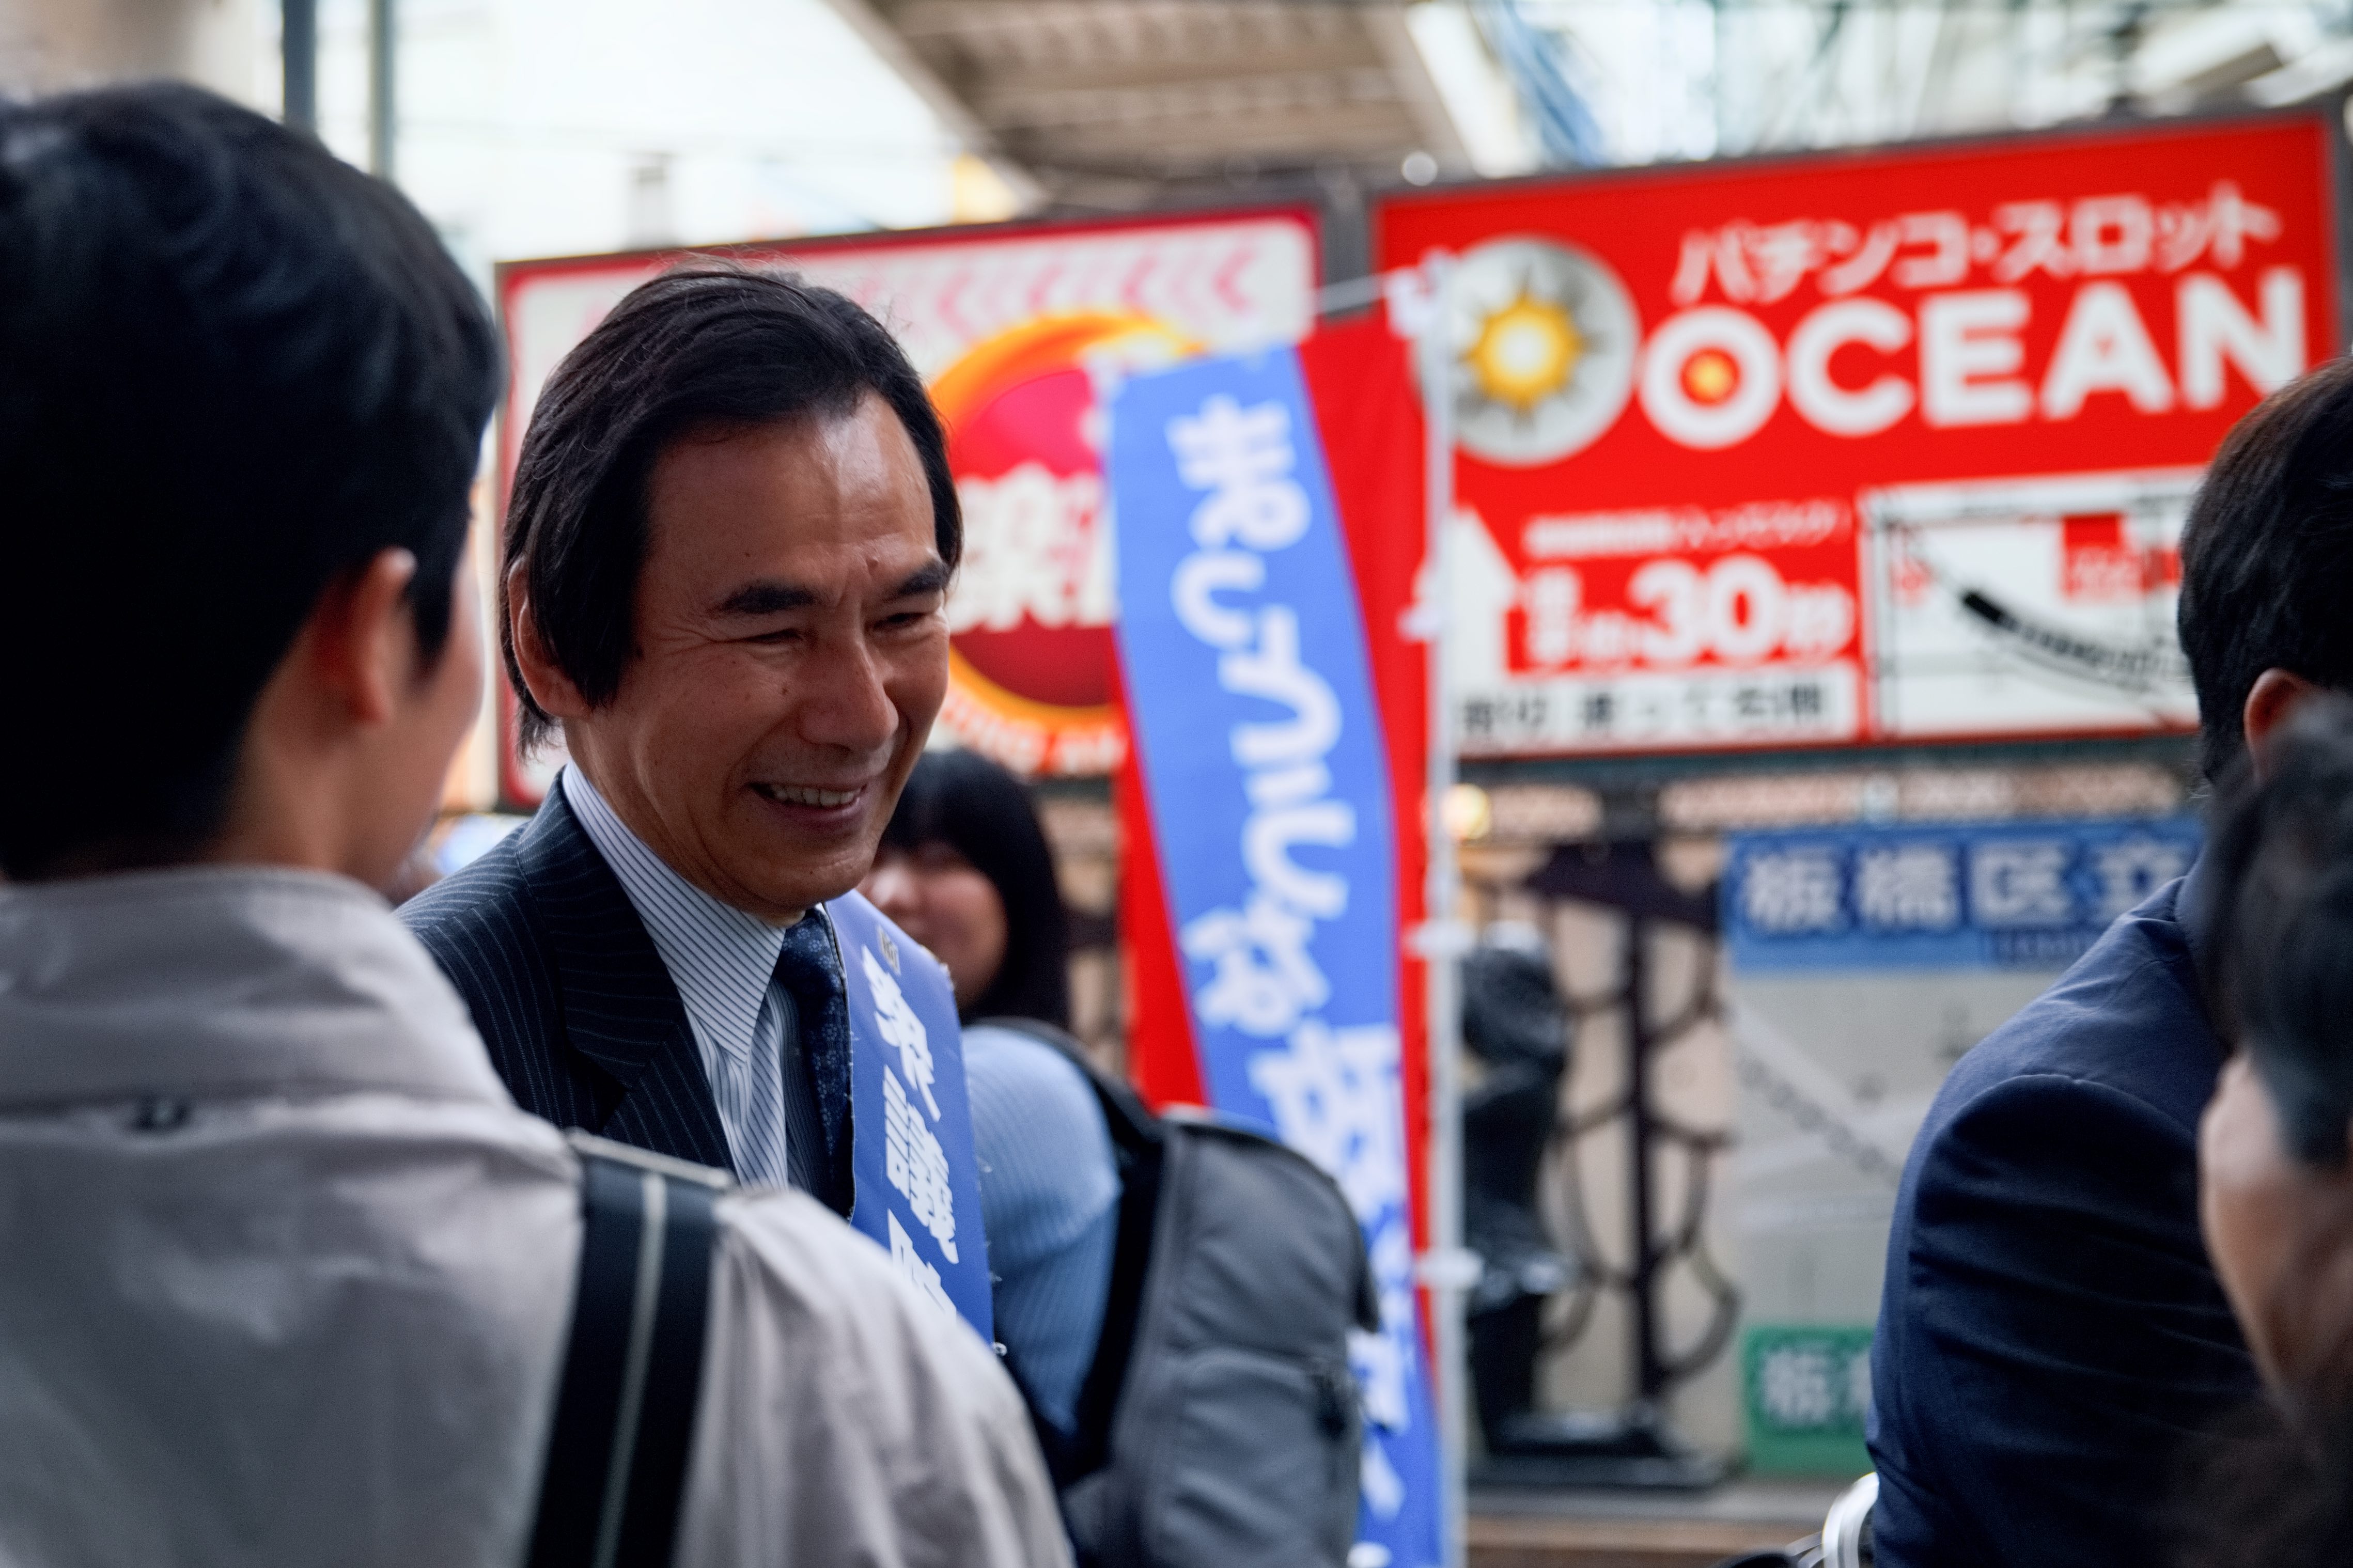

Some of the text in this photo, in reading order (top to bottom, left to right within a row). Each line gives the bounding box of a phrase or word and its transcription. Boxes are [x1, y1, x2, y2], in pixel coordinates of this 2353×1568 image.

[1670, 182, 2279, 304] パチンコ・スロット
[1640, 268, 2306, 449] OCEAN
[1759, 1345, 1876, 1426] 板
